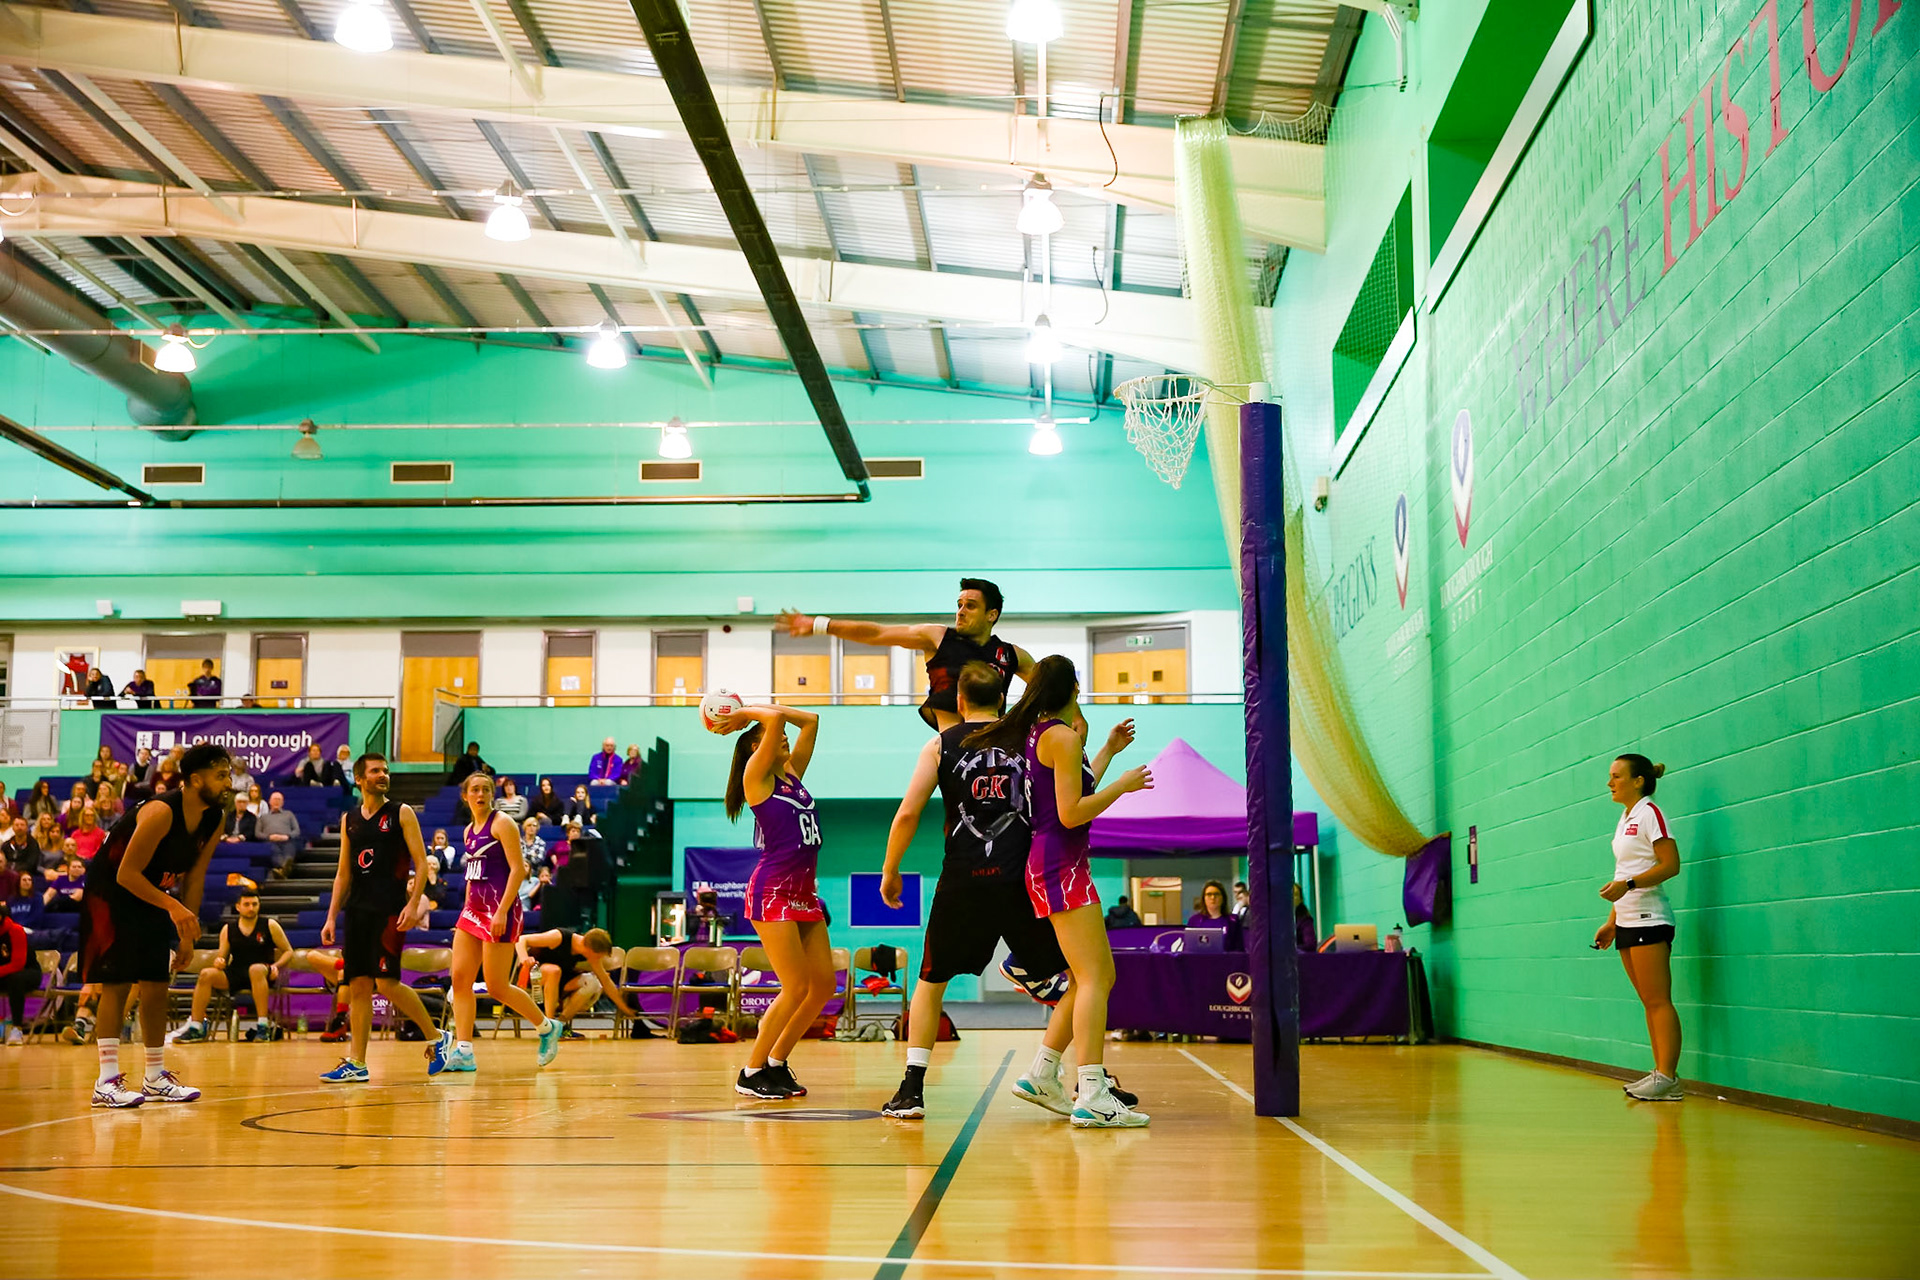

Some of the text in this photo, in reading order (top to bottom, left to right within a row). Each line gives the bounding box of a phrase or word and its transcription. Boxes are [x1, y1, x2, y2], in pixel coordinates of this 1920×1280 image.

[1512, 0, 1902, 434] WHERE HISTO
[181, 730, 313, 752] Loughborough
[971, 774, 1009, 800] GK
[799, 813, 822, 846] GA
[358, 848, 374, 869] C
